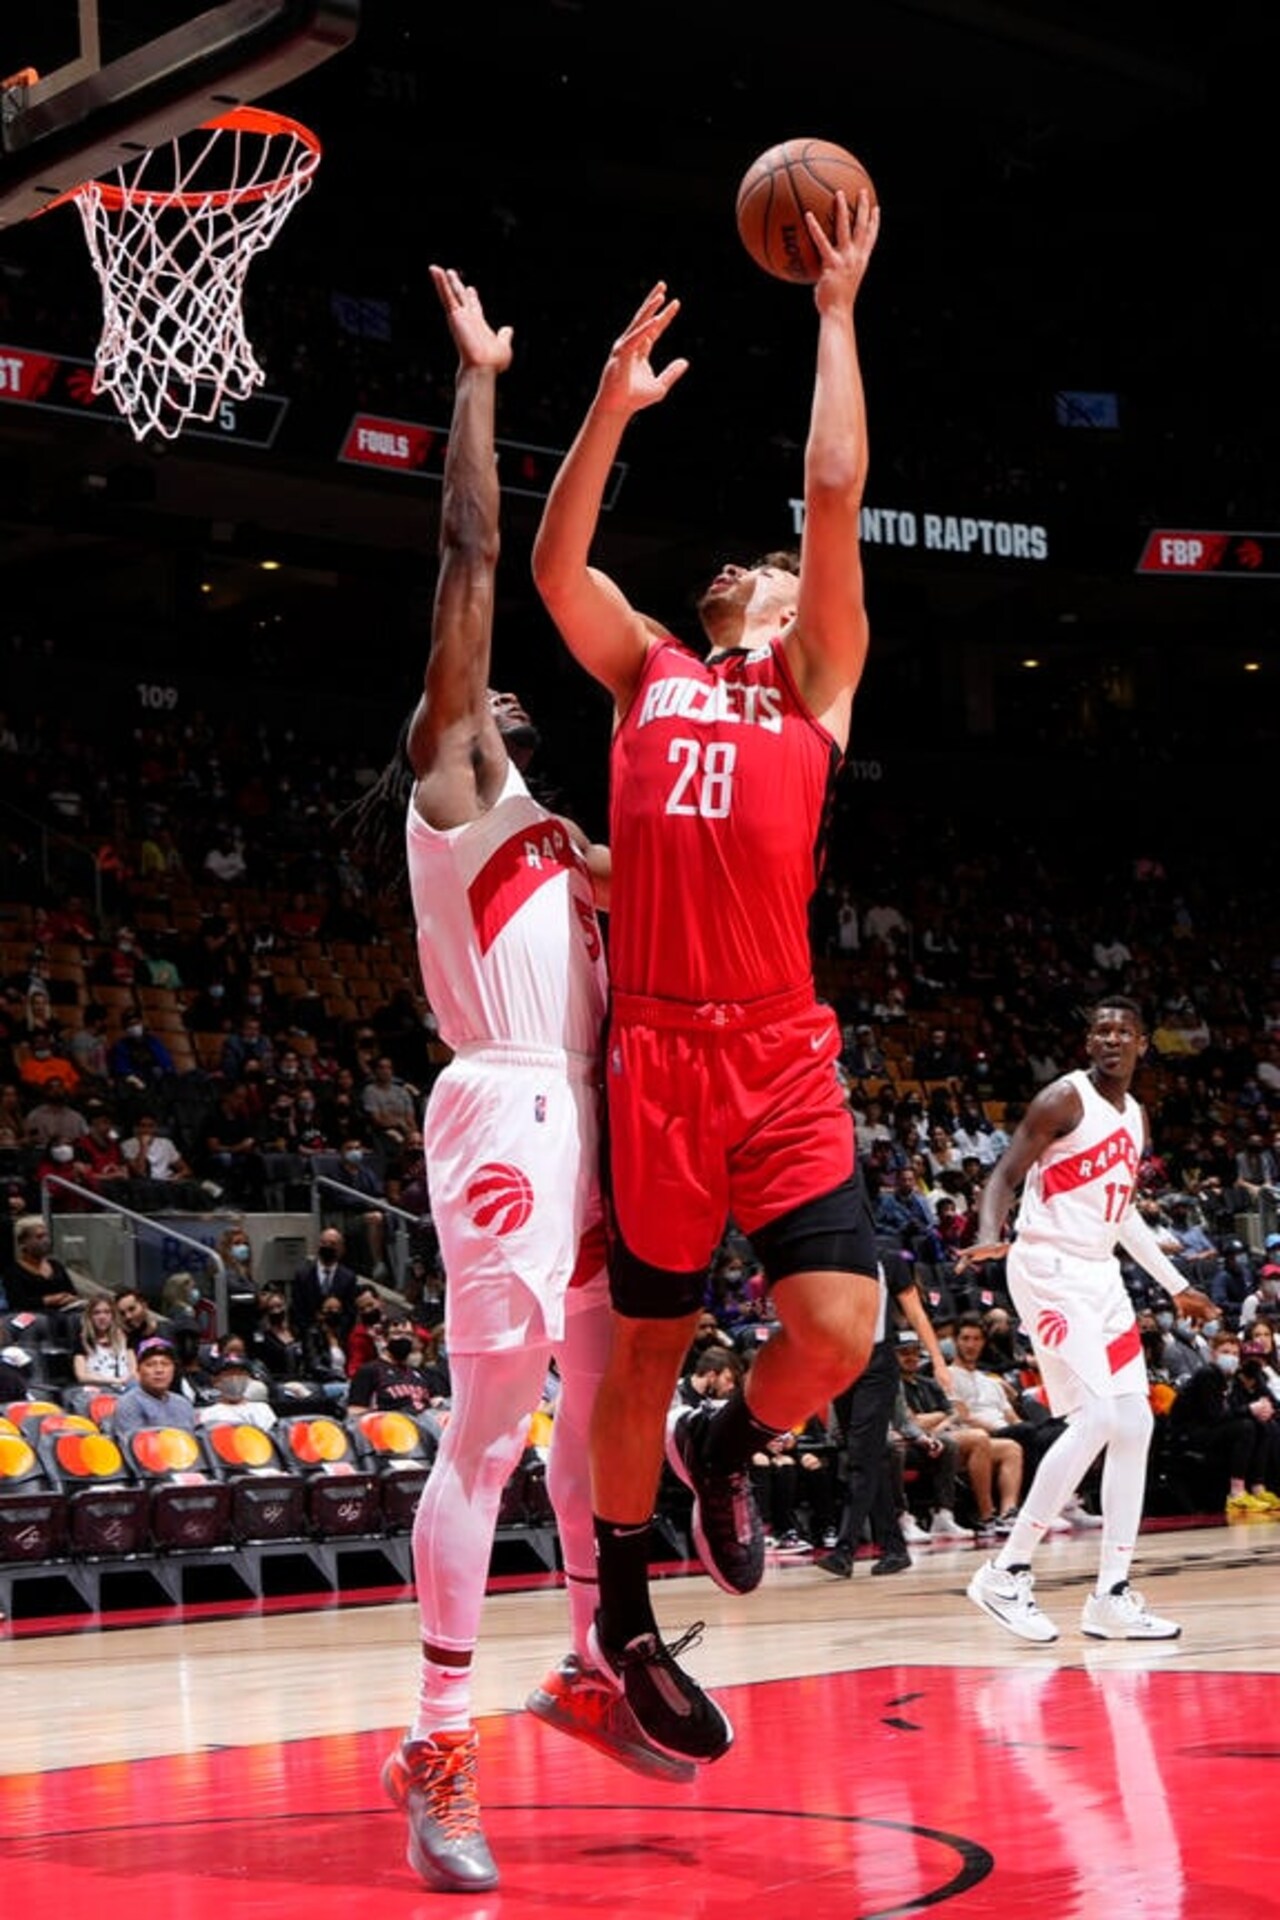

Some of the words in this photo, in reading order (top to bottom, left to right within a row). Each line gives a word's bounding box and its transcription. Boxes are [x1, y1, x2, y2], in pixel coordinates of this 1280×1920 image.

[218, 400, 236, 431] 5
[356, 427, 410, 459] FOULS
[788, 497, 918, 548] TNTO
[923, 512, 1049, 561] RAPTORS
[1160, 538, 1204, 566] FBP
[135, 682, 179, 710] 109
[636, 676, 784, 735] ROCKETS
[664, 736, 738, 820] 28
[1104, 1182, 1131, 1224] 17
